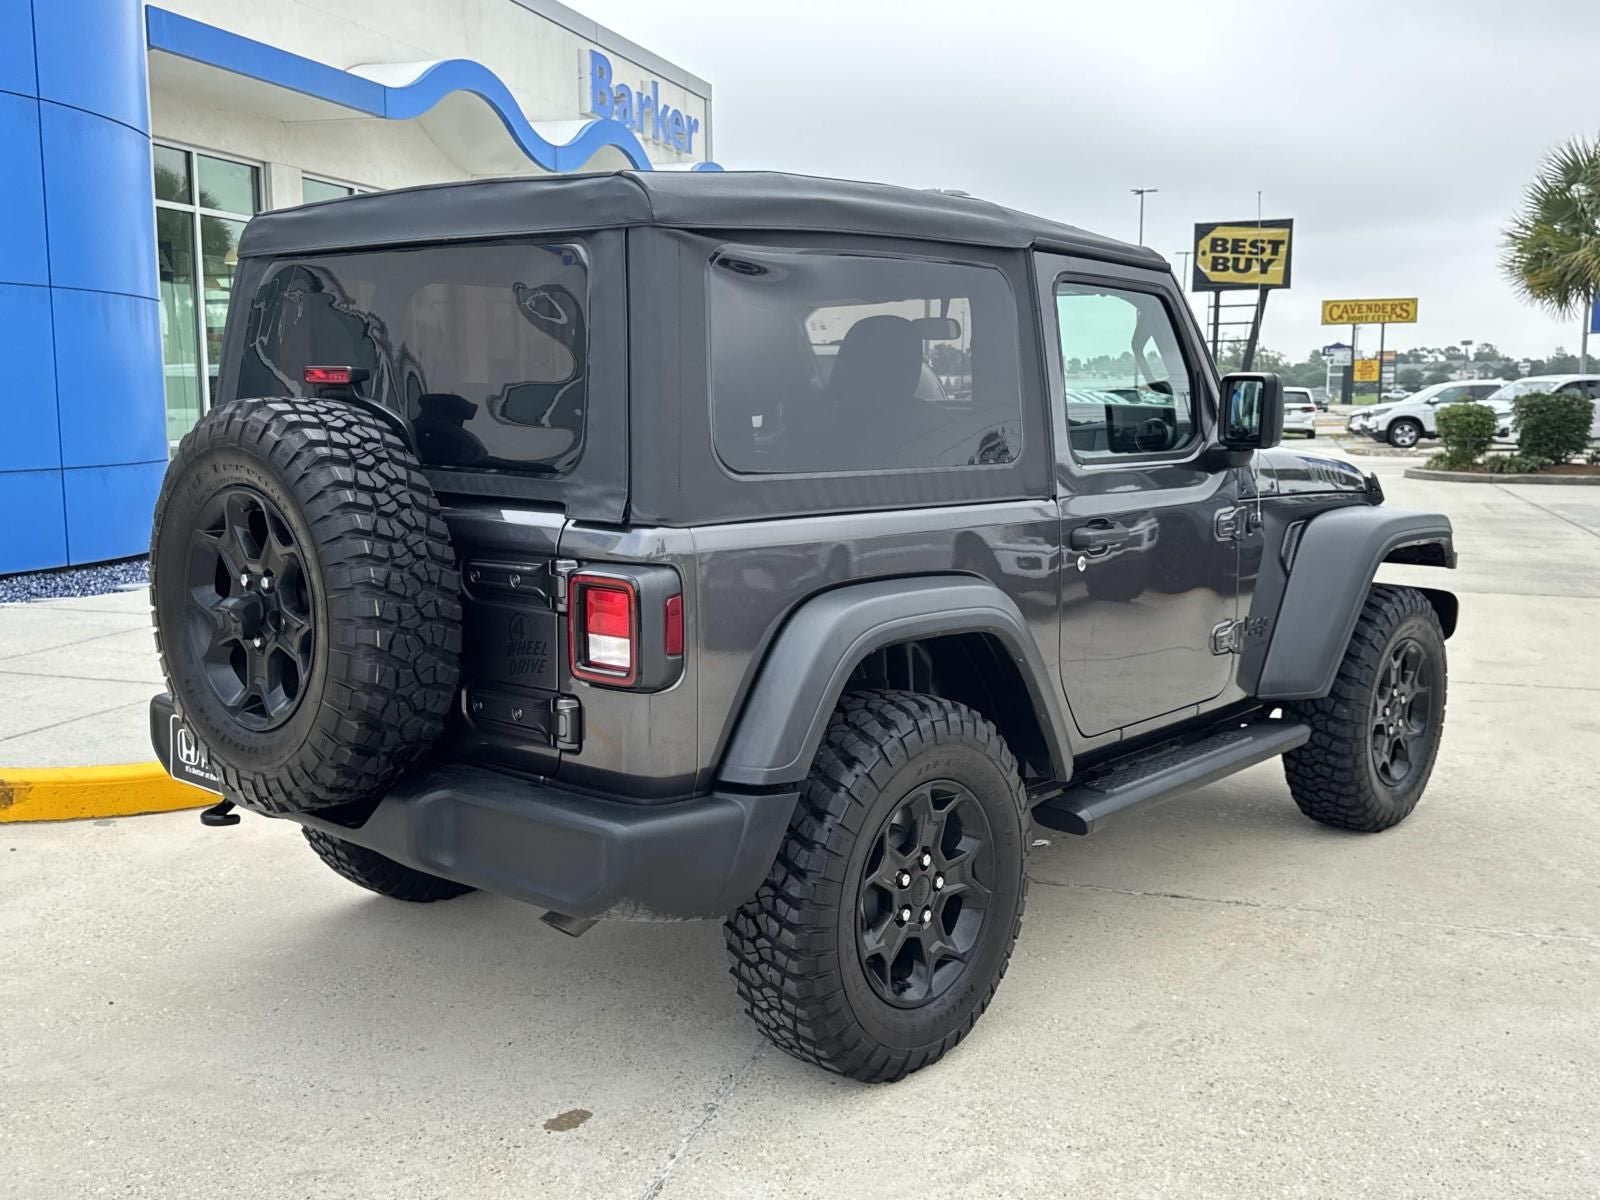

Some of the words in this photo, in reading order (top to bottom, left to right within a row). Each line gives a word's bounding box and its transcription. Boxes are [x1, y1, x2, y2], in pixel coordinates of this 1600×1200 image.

[589, 49, 700, 155] Barker
[1209, 237, 1285, 256] BEST
[1210, 256, 1279, 275] BUY
[1328, 302, 1409, 321] CAVENDER'S
[507, 640, 548, 656] WHEEL
[509, 658, 547, 675] DRIVE
